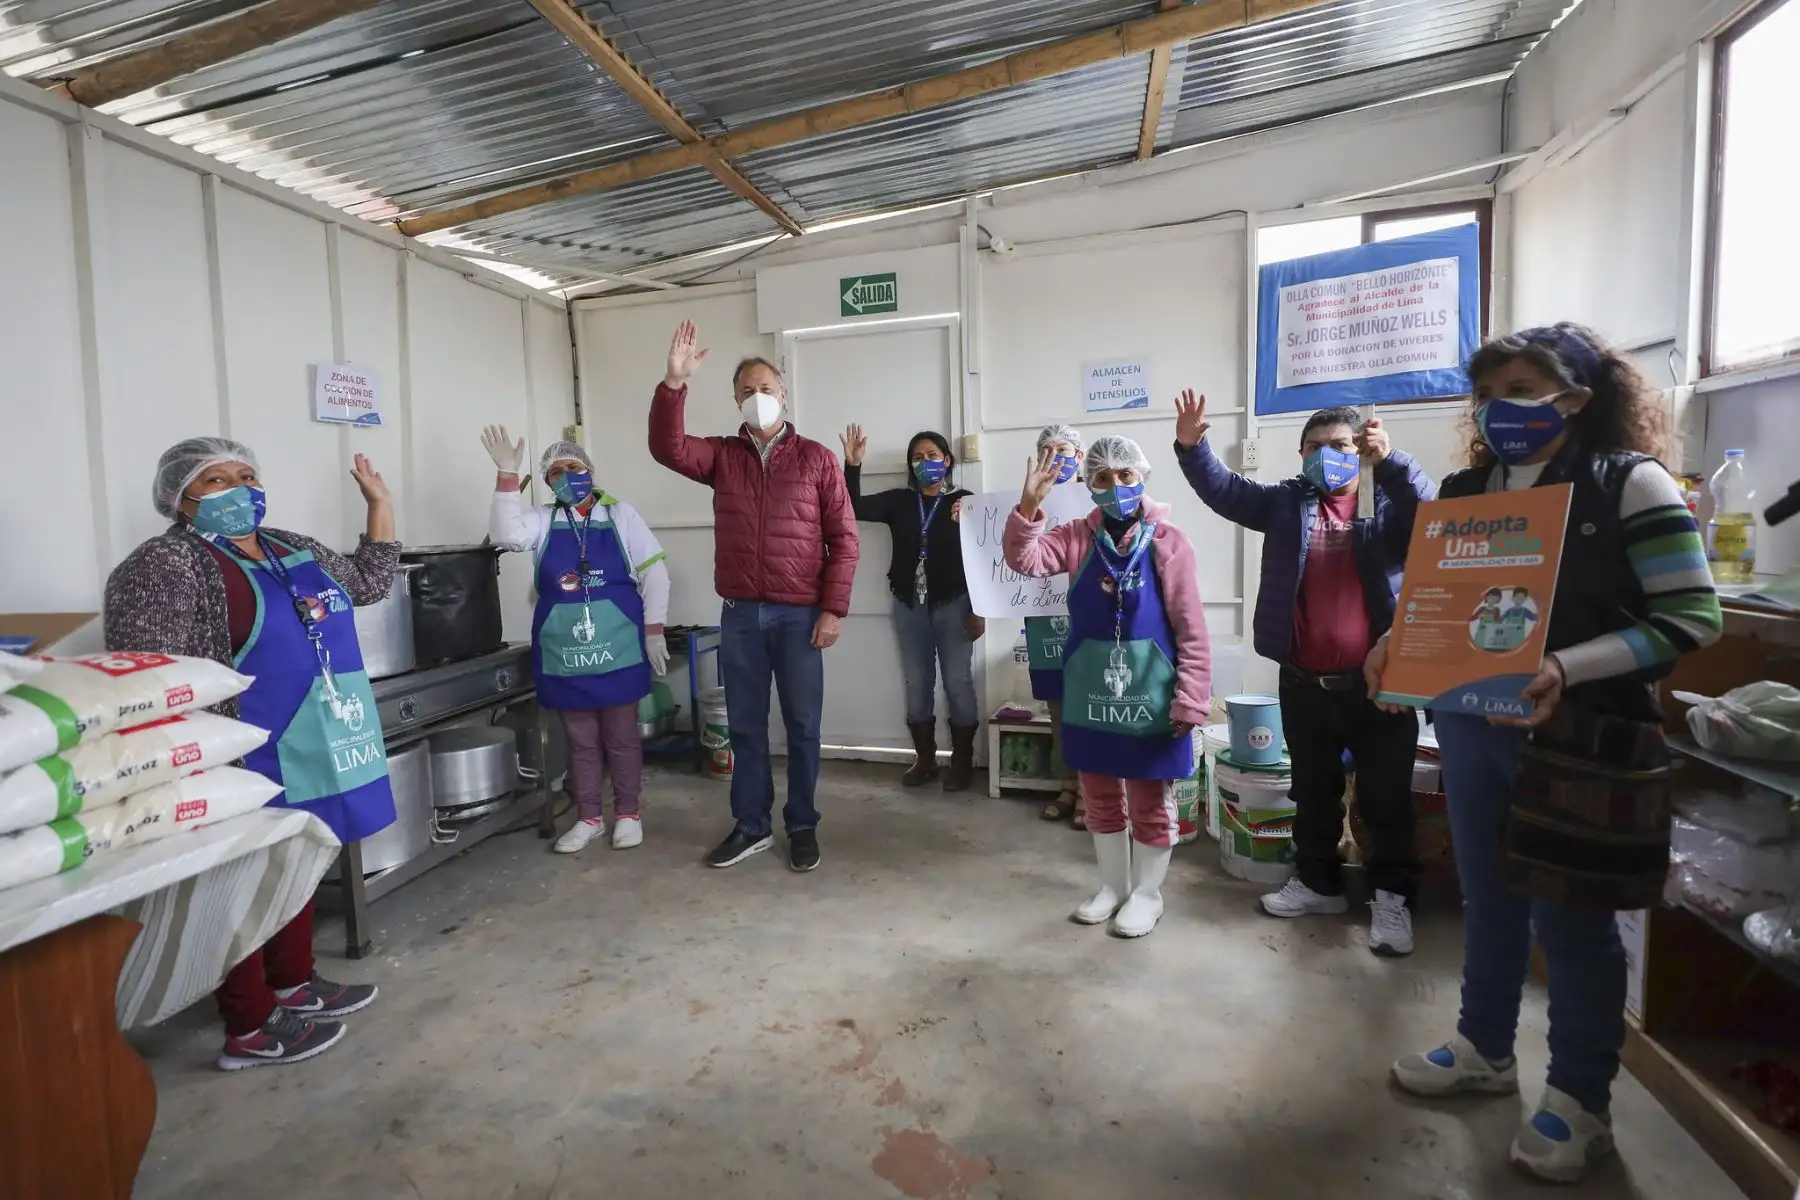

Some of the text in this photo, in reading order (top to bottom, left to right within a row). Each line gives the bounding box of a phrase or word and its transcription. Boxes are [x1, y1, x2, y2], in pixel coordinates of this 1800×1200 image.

[852, 283, 893, 305] SALIDA
[1287, 289, 1309, 304] OLLA
[1311, 282, 1347, 301] COMUN
[1298, 280, 1440, 312] Agradece al Alcalde de la
[1306, 296, 1424, 322] Municipalidad de Lima
[1287, 309, 1447, 347] Sr. JORGE MUÑOZ WELLS
[1292, 333, 1444, 361] POR LA DONACION DE VIVERES
[1092, 365, 1141, 378] ALMACEN
[1293, 351, 1438, 377] PARA NUESTRA OLLA COMUN
[331, 372, 367, 386] ZONA DE
[1111, 379, 1122, 387] DE
[327, 396, 373, 410] ALIMENTOS
[363, 389, 374, 398] DE
[1089, 388, 1147, 401] UTENSILIOS
[1313, 516, 1353, 531] idas
[1424, 515, 1528, 538] #Adopta
[1011, 580, 1067, 607] de Lim
[563, 650, 613, 668] LIMA
[1043, 644, 1064, 658] LI
[1088, 704, 1153, 723] LIMA
[1485, 701, 1524, 715] LIMA
[333, 742, 381, 773] LIMA
